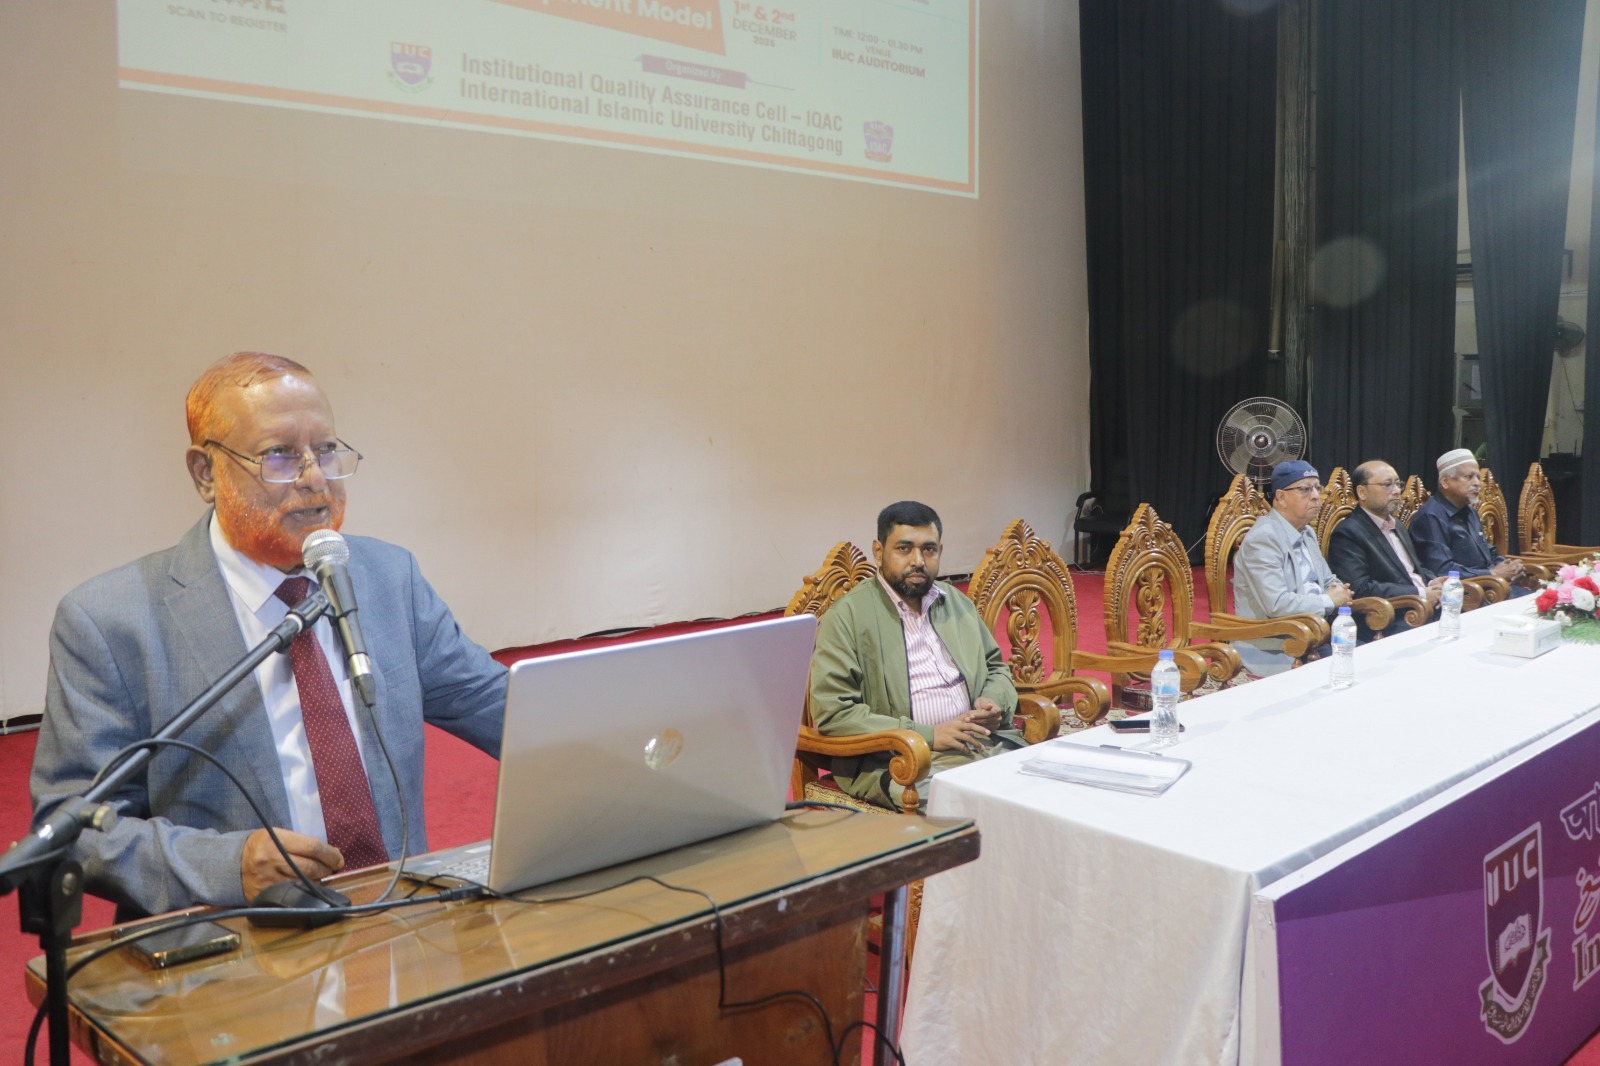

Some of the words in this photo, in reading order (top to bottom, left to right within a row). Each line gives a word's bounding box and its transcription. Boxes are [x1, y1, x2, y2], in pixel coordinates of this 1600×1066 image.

[167, 4, 205, 19] SCAN
[209, 11, 227, 23] TO
[230, 15, 288, 33] REGISTER
[637, 0, 712, 30] Model
[755, 5, 768, 21] &
[772, 8, 795, 24] 2nd
[732, 17, 797, 42] DECEMBER
[831, 48, 855, 62] IIUC
[857, 54, 926, 78] AUDITORIUM
[865, 45, 892, 58] VENUE
[910, 44, 923, 55] PM
[665, 60, 710, 77] Organized
[711, 68, 721, 82] by
[462, 52, 584, 90] Institutional
[590, 73, 656, 105] Quality
[662, 85, 750, 117] Assurance
[756, 101, 787, 123] Cell
[806, 110, 843, 132] IQAC
[460, 77, 590, 115] International
[597, 97, 665, 126] Islamic
[671, 109, 756, 143] University
[761, 124, 843, 156] Chittagong
